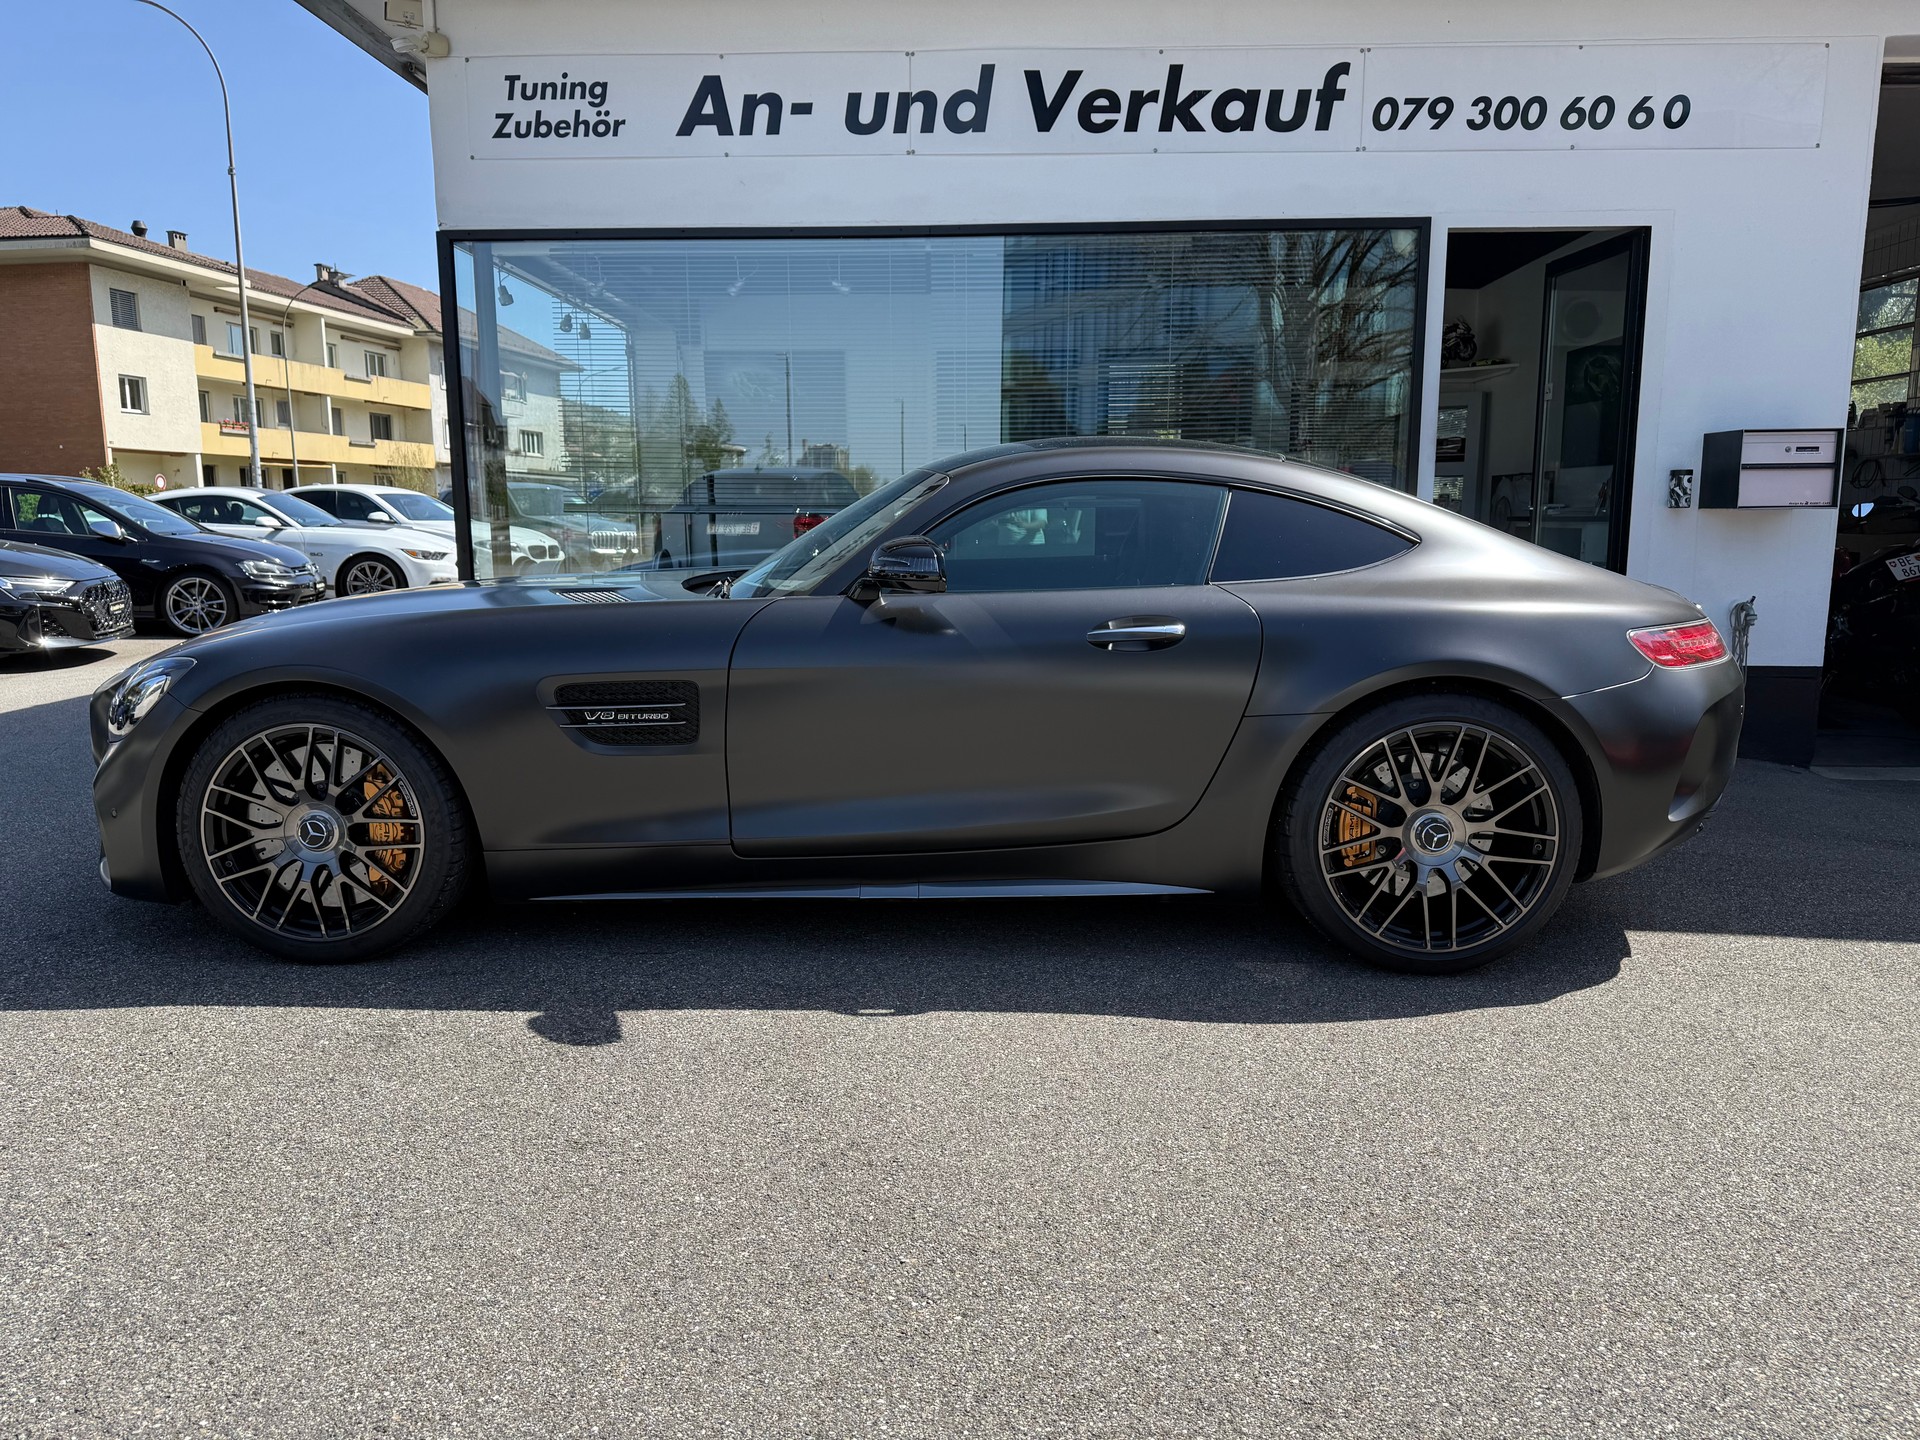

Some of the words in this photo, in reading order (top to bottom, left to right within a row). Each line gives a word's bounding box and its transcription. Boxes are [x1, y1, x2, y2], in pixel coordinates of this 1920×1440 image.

[504, 72, 608, 108] Tuning
[675, 74, 814, 137] An-
[844, 63, 996, 136] und
[1023, 61, 1351, 134] Verkauf
[491, 109, 626, 140] Zubehör
[1372, 96, 1455, 132] 079
[1466, 95, 1548, 131] 300
[1559, 95, 1616, 131] 60
[1896, 555, 1915, 568] BE
[584, 711, 615, 720] V8
[617, 712, 669, 720] BITURBO
